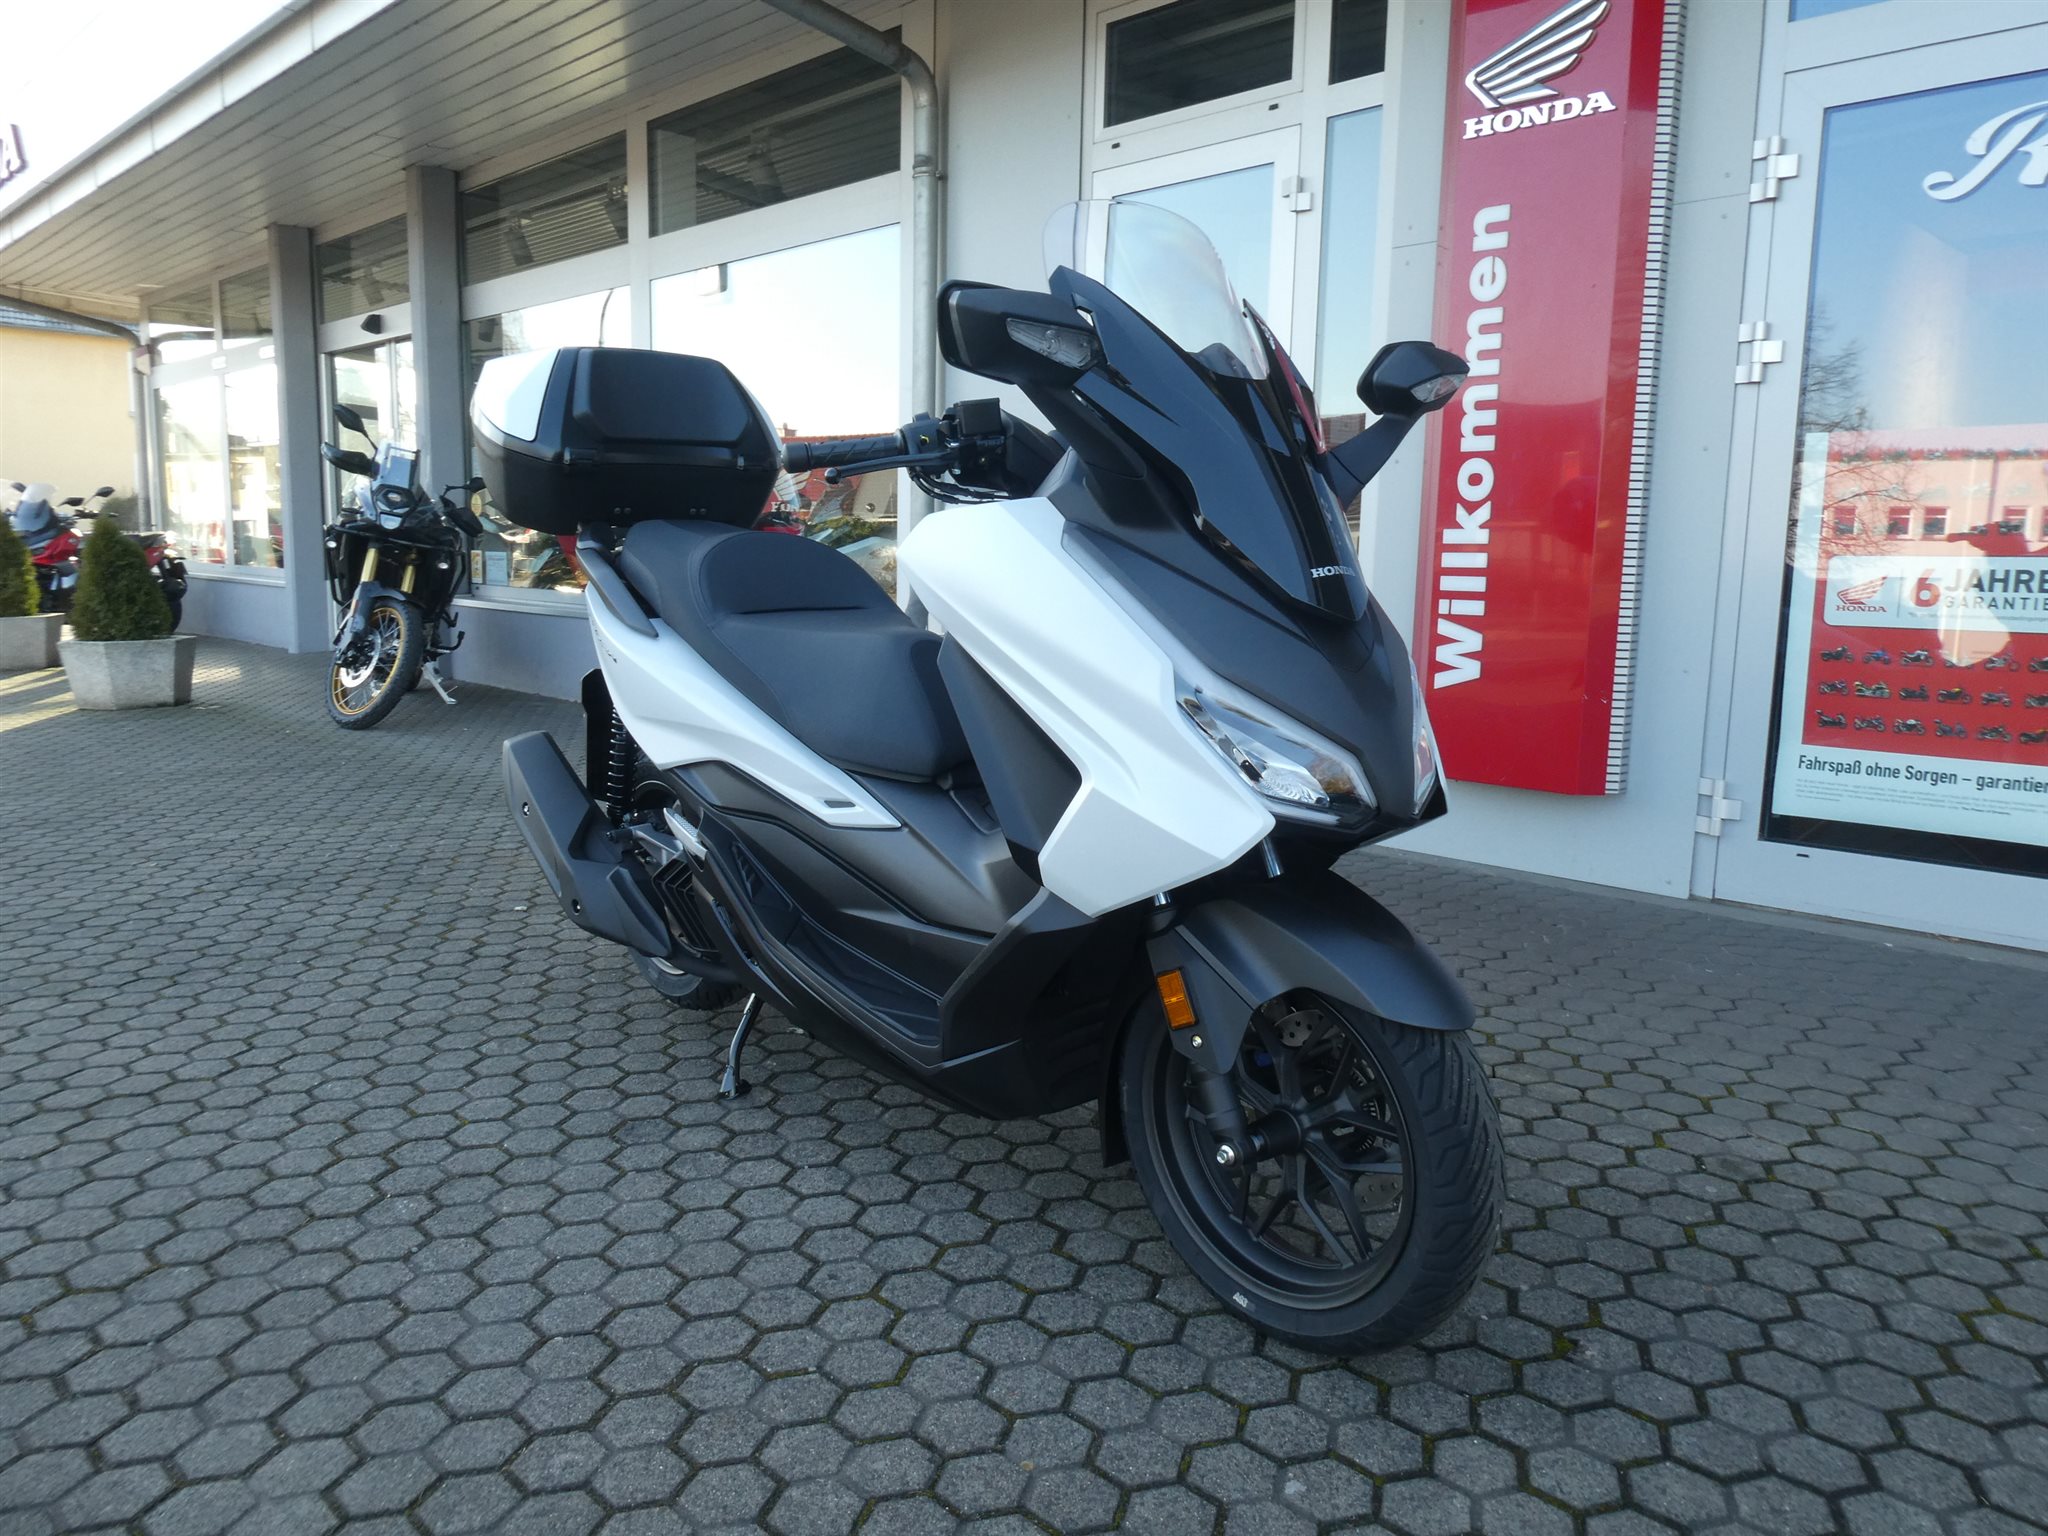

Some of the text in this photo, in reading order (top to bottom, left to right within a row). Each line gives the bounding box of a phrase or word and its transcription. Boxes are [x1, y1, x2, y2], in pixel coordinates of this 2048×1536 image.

[1462, 91, 1617, 139] HONDA
[1433, 203, 1511, 690] Willkommen
[1910, 568, 2048, 608] 6 JAHRE
[1945, 596, 2048, 611] GARANTIE
[1798, 754, 1862, 776] Fahrspaß
[1865, 762, 1901, 779] ohne
[1904, 765, 1958, 786] Sorgen
